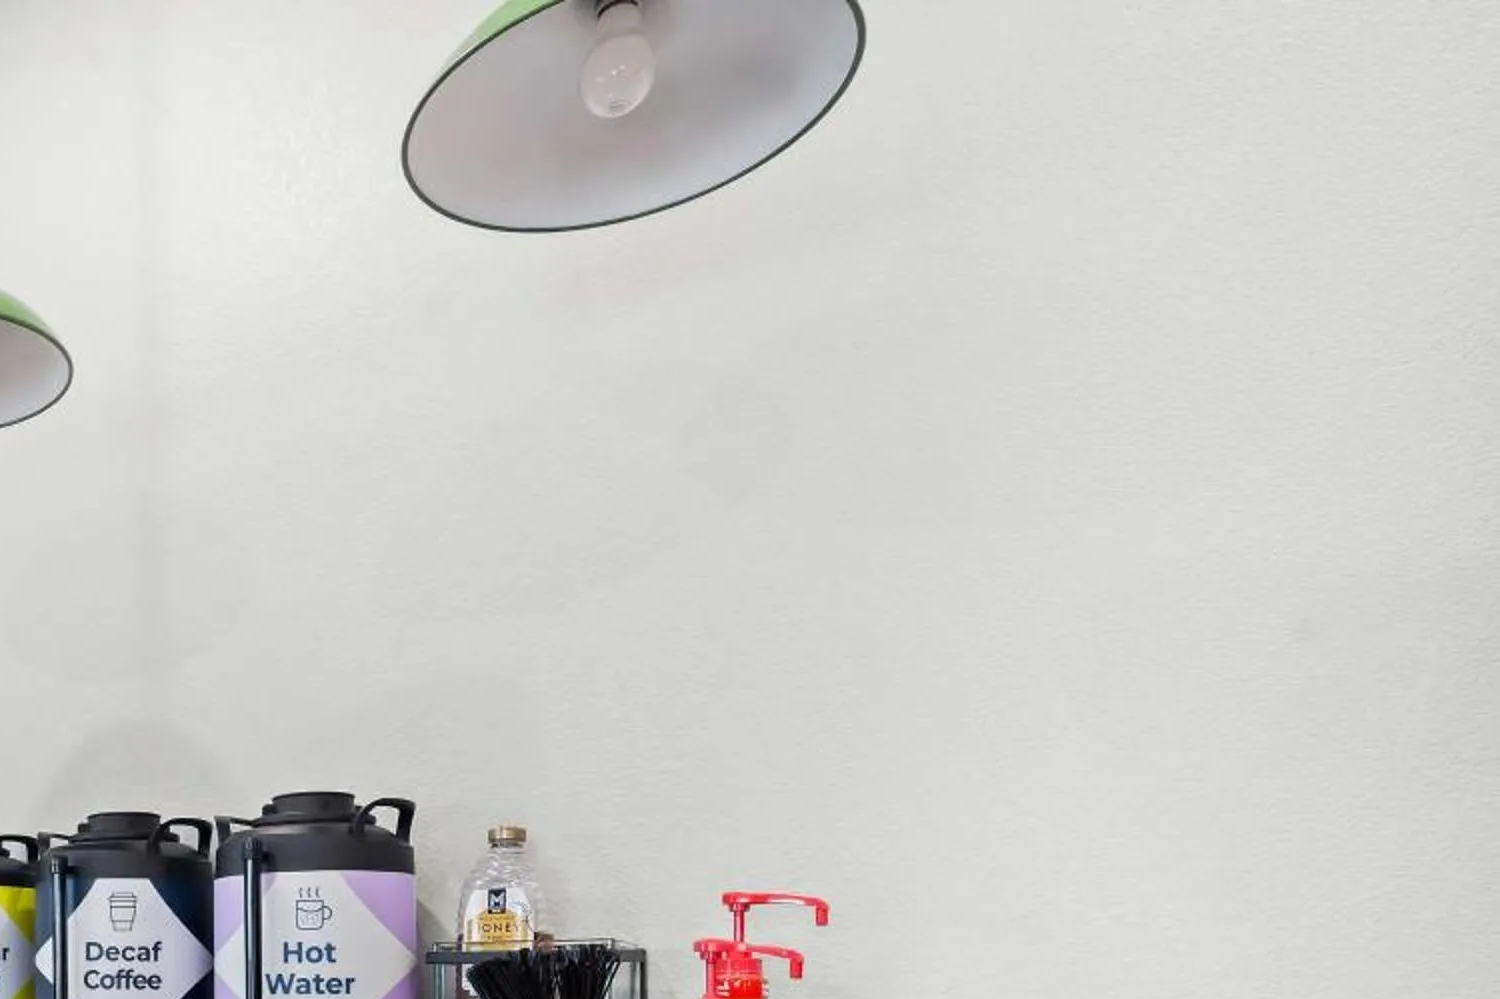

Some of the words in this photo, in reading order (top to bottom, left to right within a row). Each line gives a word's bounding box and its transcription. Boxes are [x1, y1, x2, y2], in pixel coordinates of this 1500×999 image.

[85, 941, 162, 961] Decaf
[283, 941, 337, 963] Hot
[83, 969, 162, 990] Coffee
[265, 973, 356, 994] Water
